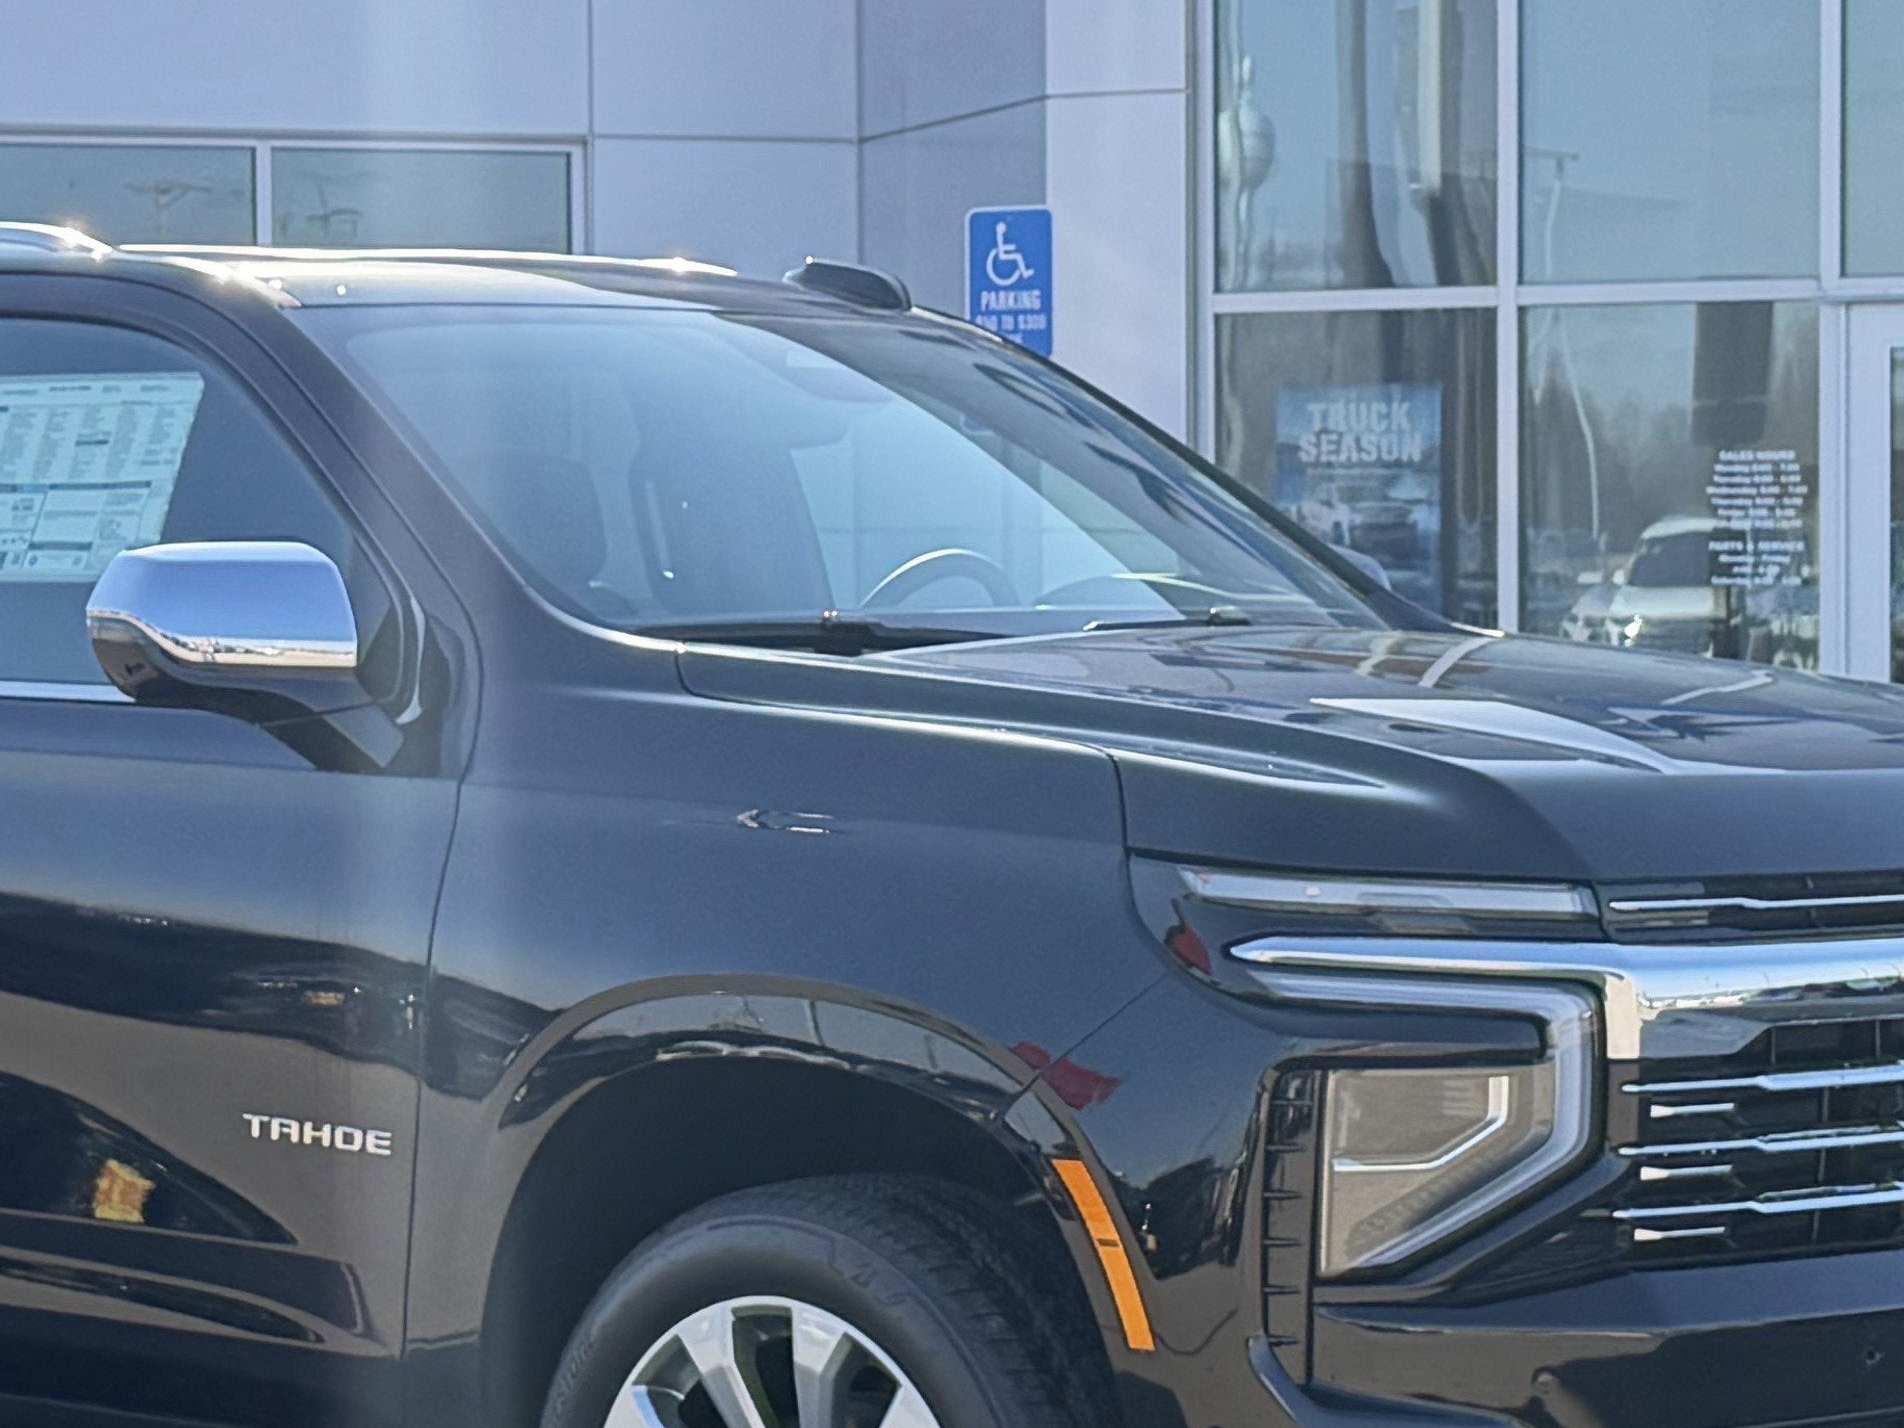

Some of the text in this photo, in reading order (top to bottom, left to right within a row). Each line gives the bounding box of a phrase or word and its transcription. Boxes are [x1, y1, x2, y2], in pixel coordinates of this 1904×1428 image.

[1305, 400, 1412, 433] TRUCK
[1297, 432, 1424, 464] SEASON
[242, 1113, 393, 1156] TAHOE
